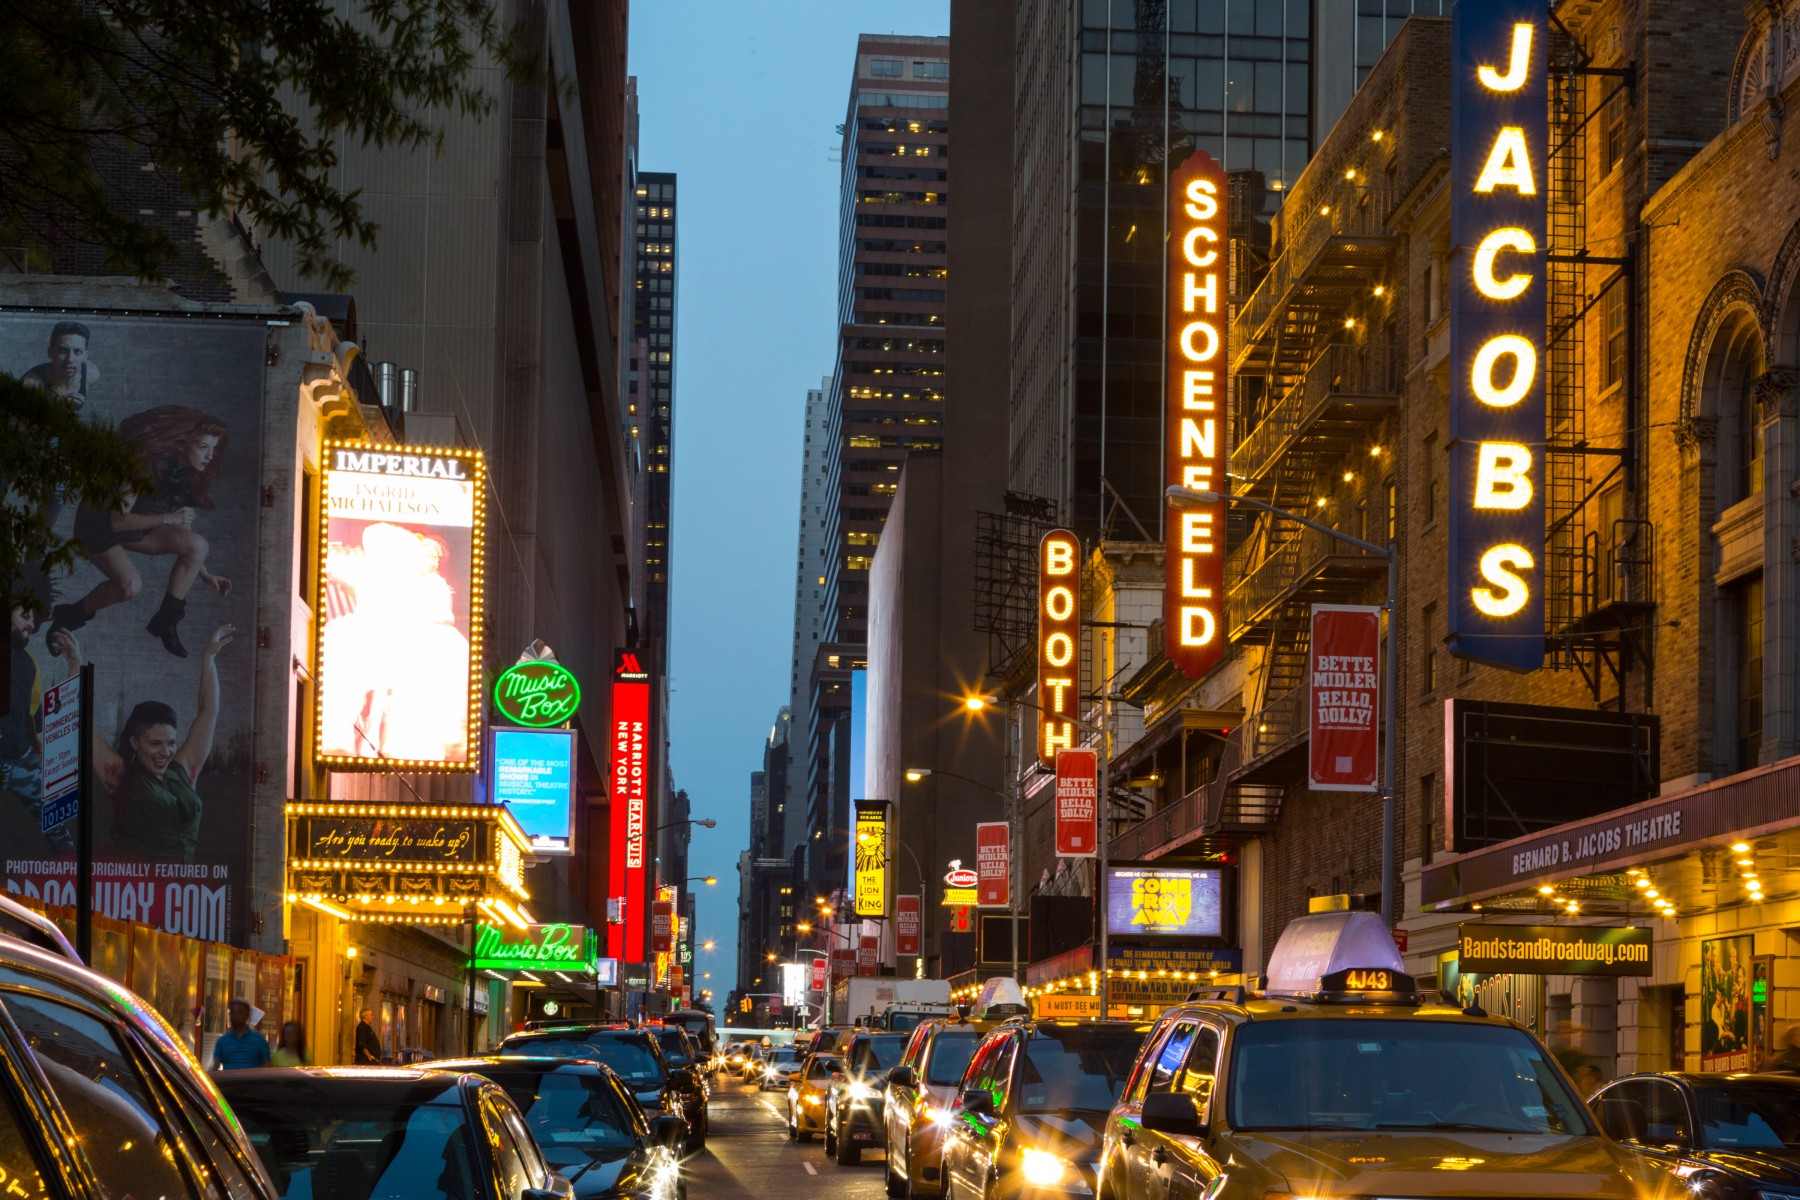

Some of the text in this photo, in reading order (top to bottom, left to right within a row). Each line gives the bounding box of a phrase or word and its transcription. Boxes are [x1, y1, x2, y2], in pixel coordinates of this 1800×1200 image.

[1471, 22, 1537, 618] JACOBS
[336, 451, 466, 479] IMPERIAL
[356, 483, 415, 499] INGRID
[1044, 540, 1073, 757] BOOTH
[1318, 655, 1373, 672] BETTE
[505, 669, 568, 698] Music
[1314, 672, 1376, 689] MIDLER
[517, 692, 574, 719] Box
[1318, 691, 1373, 709] HELLO,
[1318, 708, 1372, 725] DOLLY!
[616, 722, 628, 794] NEW YORK
[1060, 778, 1093, 788] BETTE
[630, 722, 642, 866] MARRIOTT MARQUIS
[1058, 788, 1095, 797] MIDLER
[1060, 798, 1093, 810] HELLO,
[44, 800, 78, 829] 101330
[1060, 808, 1092, 818] DOLLY!
[315, 826, 470, 856] Are you ready to wake up?
[1513, 810, 1681, 875] BERNARD B. JACOBS THEATRE
[978, 852, 1008, 861] MIDLER
[980, 846, 1006, 854] BETTE
[156, 864, 208, 878] FEATURED
[213, 864, 228, 878] ON
[1132, 878, 1192, 894] COME
[858, 897, 882, 910] KING
[1132, 893, 1192, 910] FROM
[1131, 909, 1192, 926] AWAY
[476, 922, 579, 960] Music Box
[1135, 950, 1171, 959] REMARKABLE
[1172, 951, 1186, 959] TRUE
[1188, 951, 1205, 960] STORY
[1206, 952, 1214, 960] OF
[1464, 936, 1648, 965] BandstandBroadway.com
[1168, 960, 1199, 968] WELCOMED
[1112, 981, 1133, 992] TONY
[1135, 981, 1167, 993] AWARD
[1346, 970, 1388, 990] 4J43
[1054, 1002, 1087, 1010] MUST-SEE
